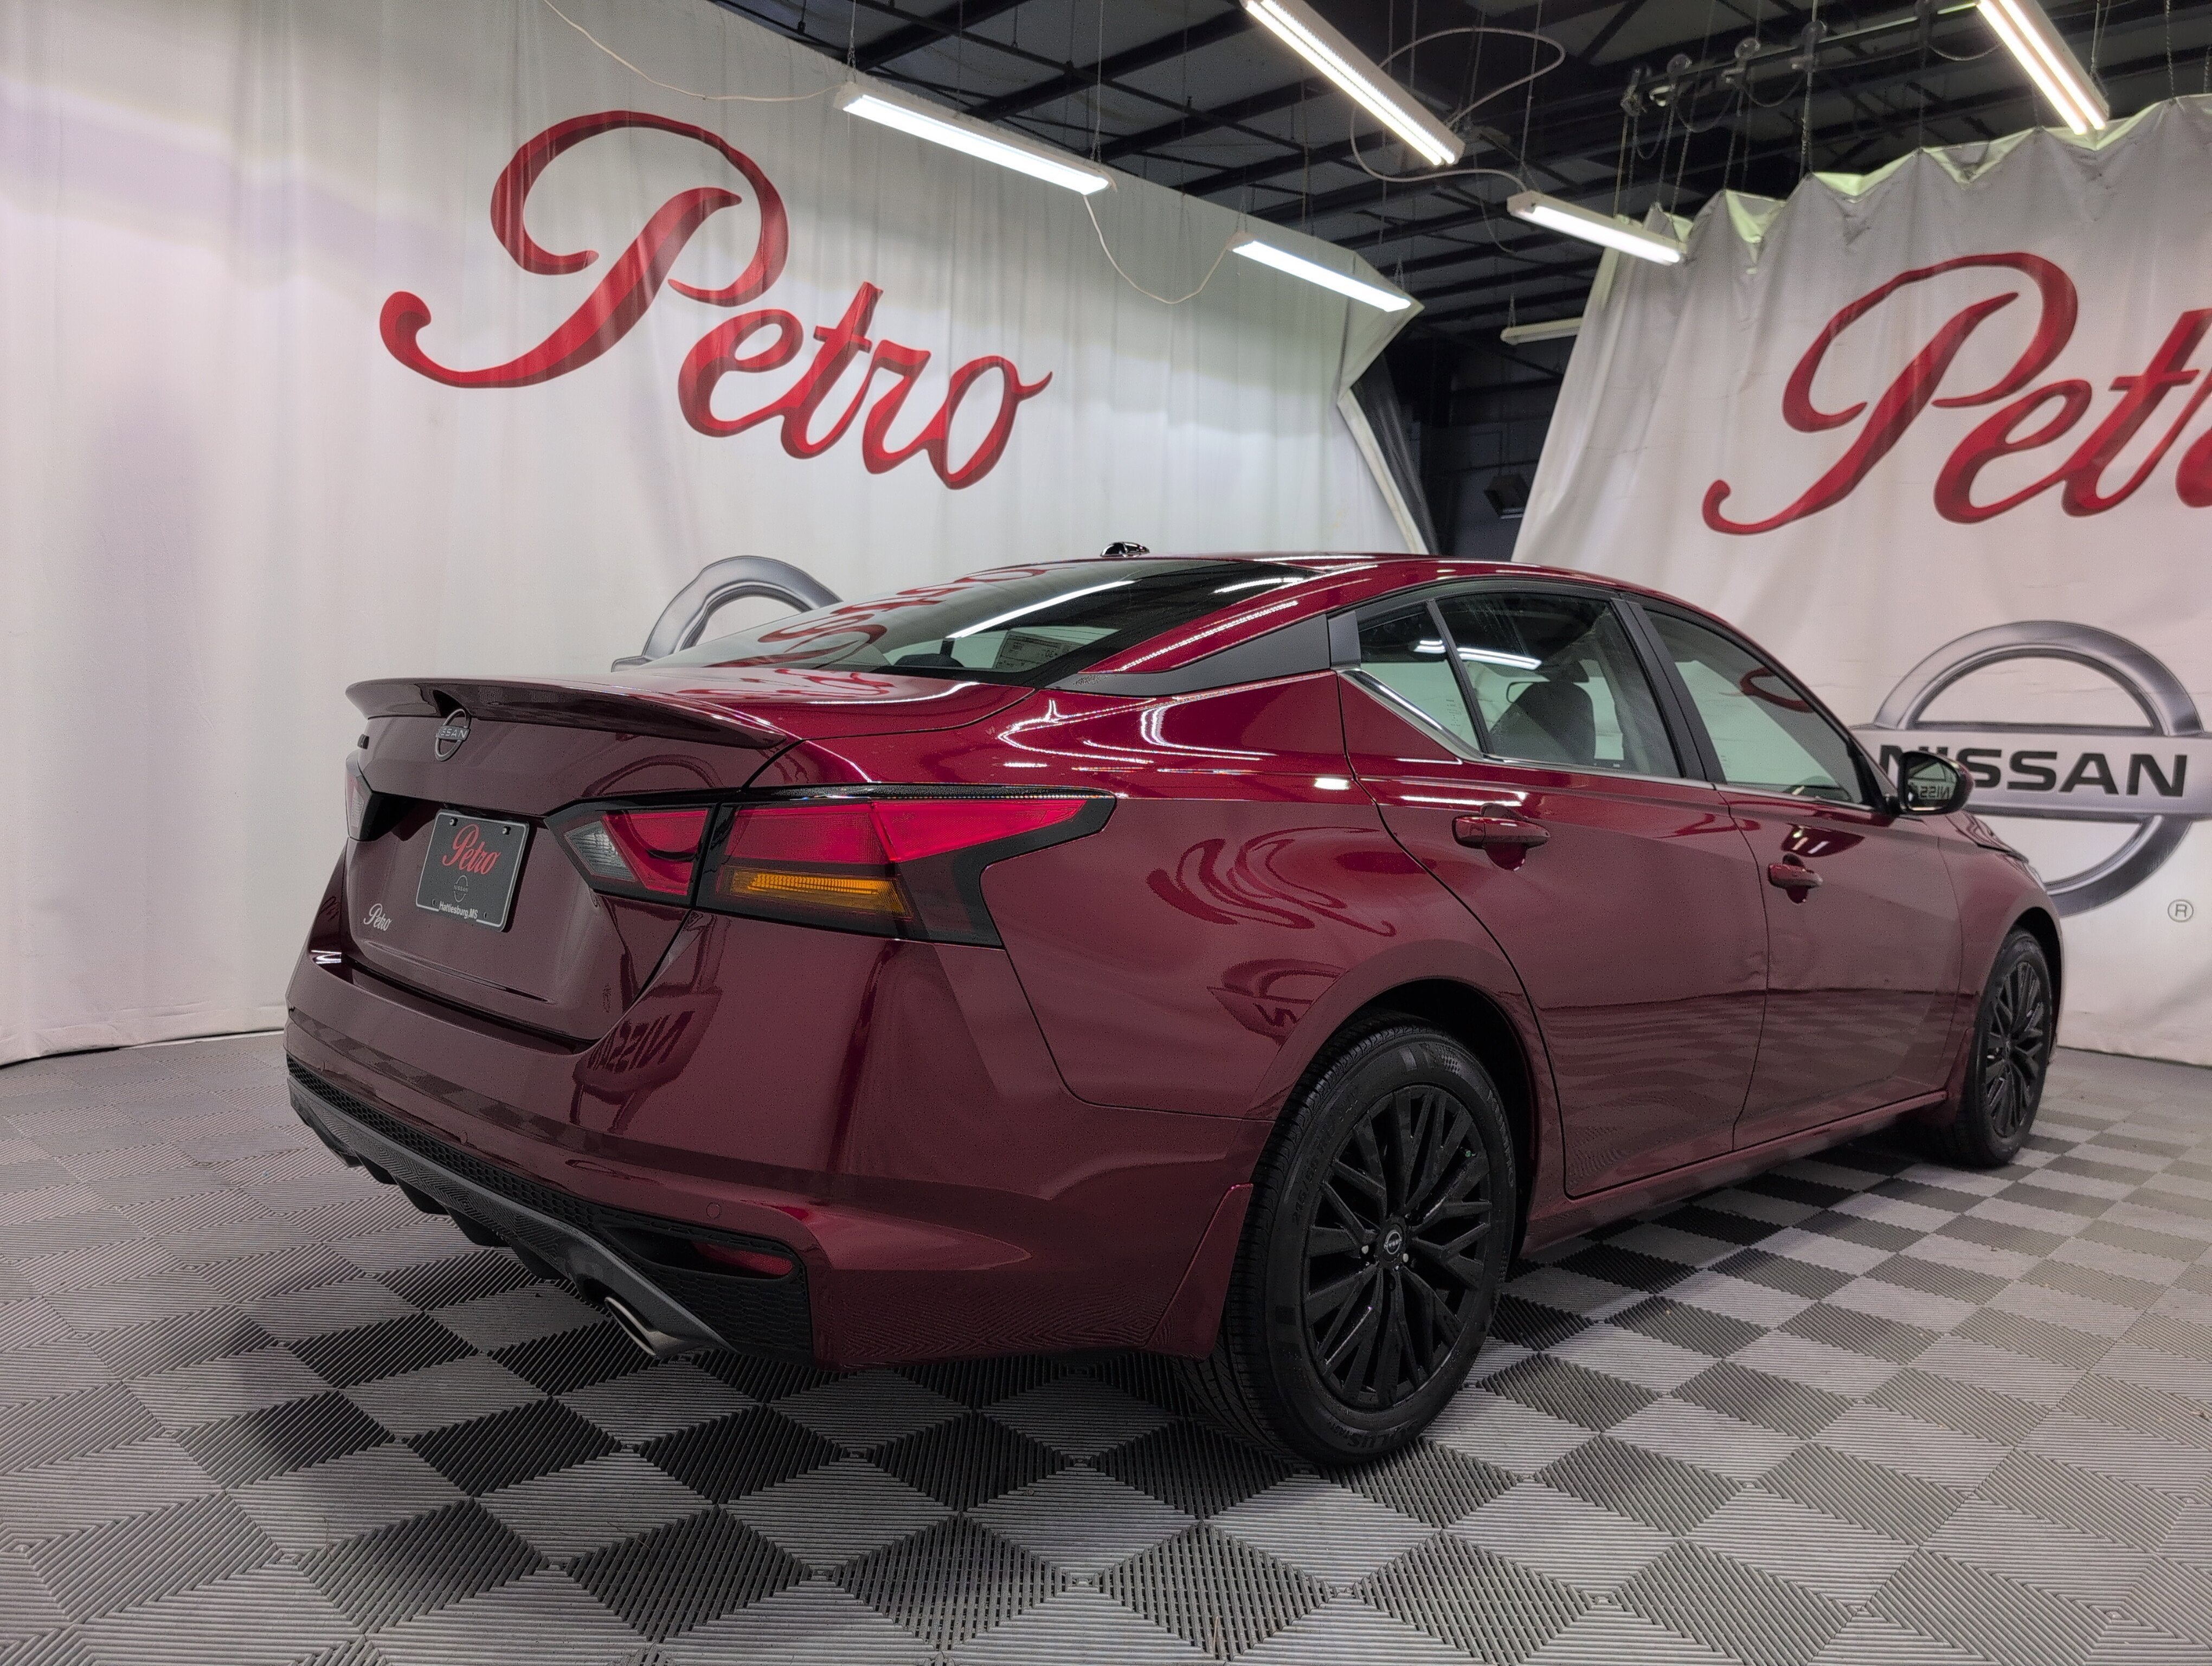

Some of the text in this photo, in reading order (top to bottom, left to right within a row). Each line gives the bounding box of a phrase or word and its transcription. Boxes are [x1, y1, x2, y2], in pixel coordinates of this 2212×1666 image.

[378, 110, 1053, 490] Petro
[1878, 744, 2188, 798] SSAN
[442, 823, 501, 875] Petro
[363, 903, 392, 931] Petro
